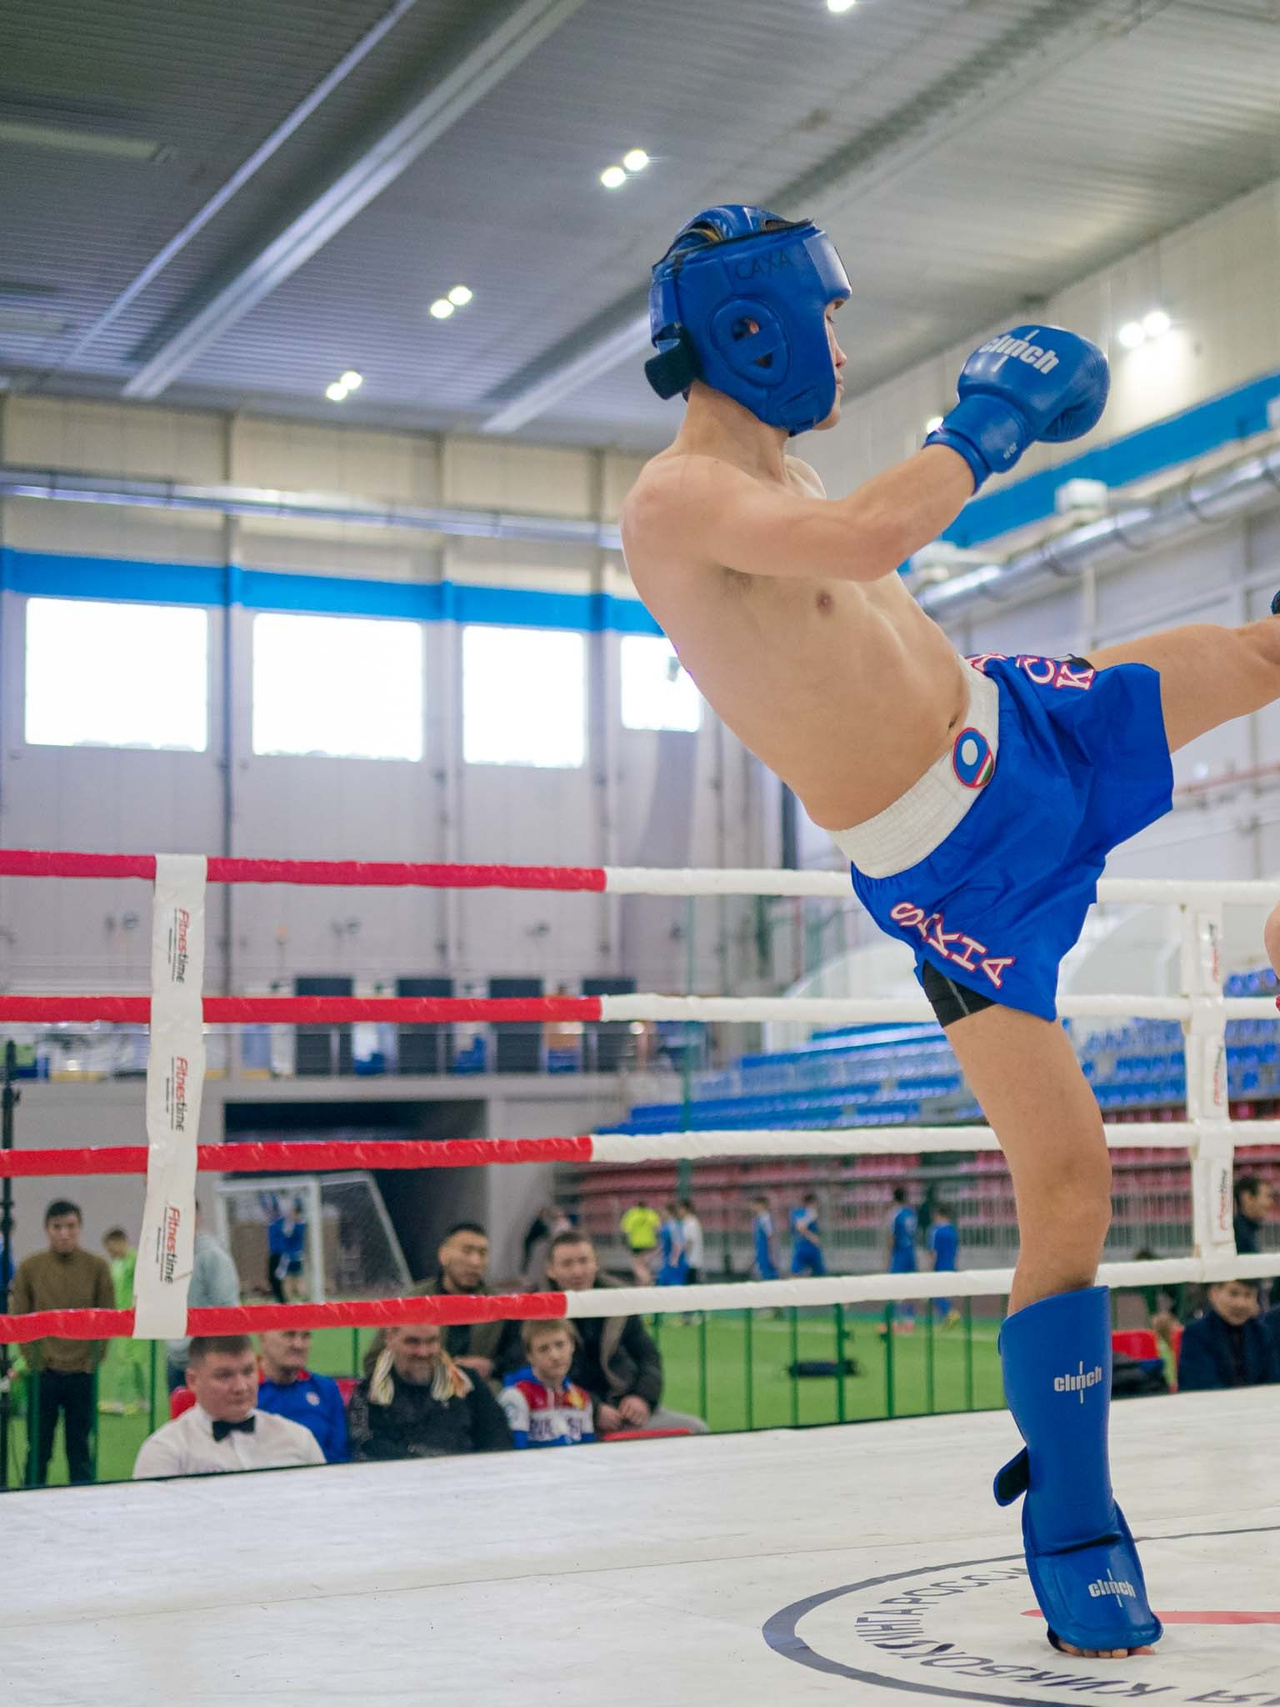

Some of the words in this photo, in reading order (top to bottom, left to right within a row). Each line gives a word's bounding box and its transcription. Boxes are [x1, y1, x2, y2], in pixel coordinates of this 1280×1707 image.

[978, 333, 1060, 375] clinch
[1054, 1365, 1102, 1392] clinch
[1088, 1579, 1136, 1598] clinch
